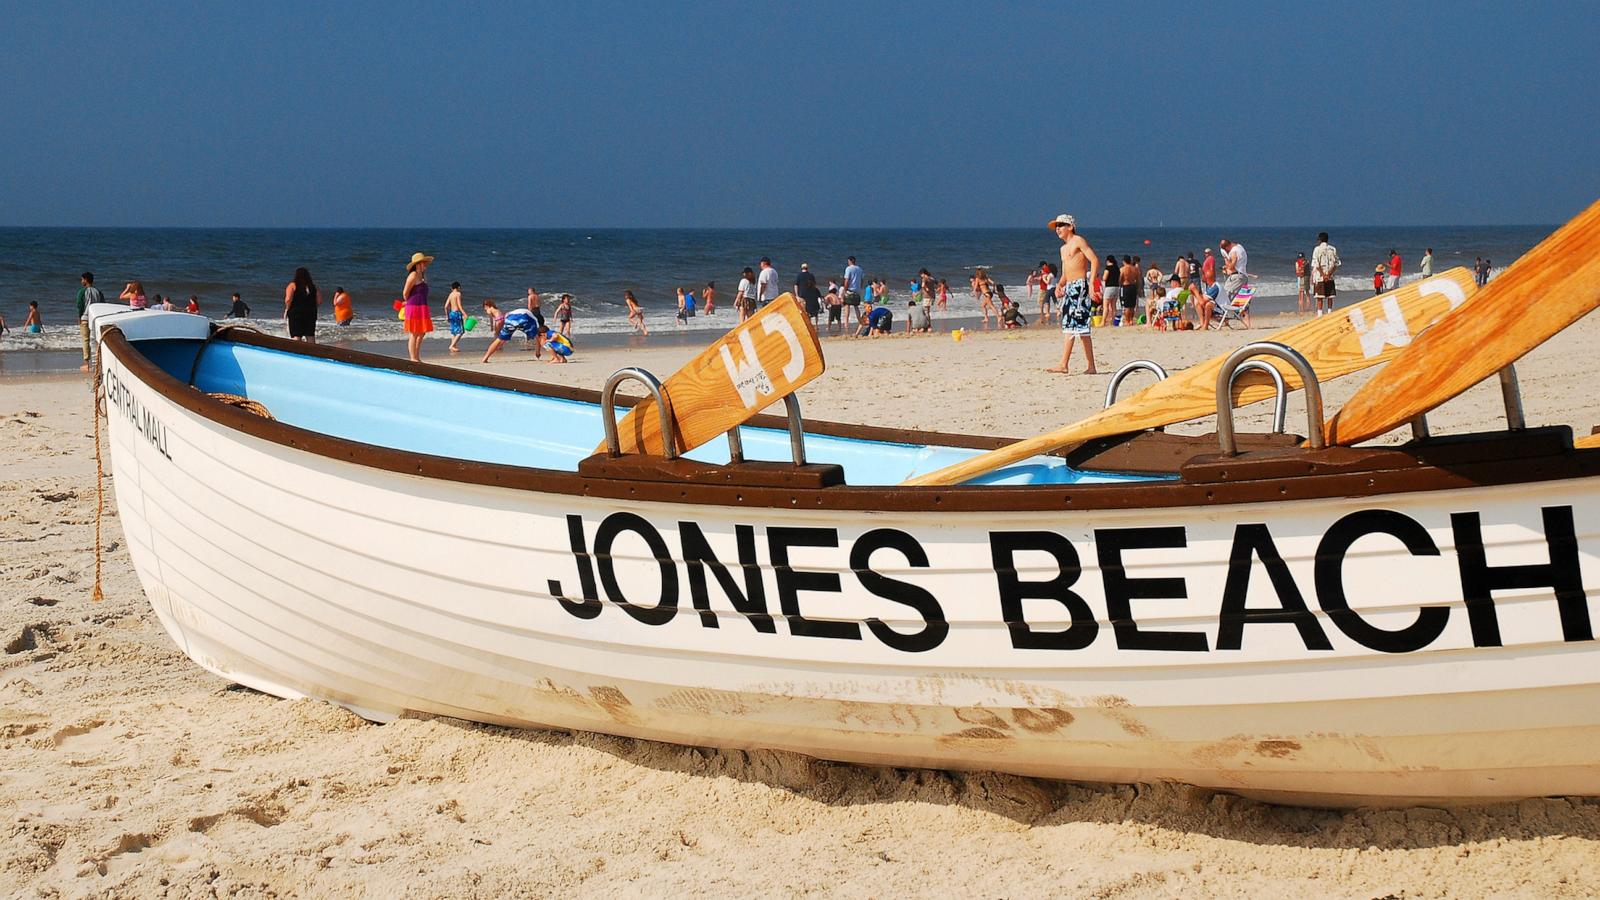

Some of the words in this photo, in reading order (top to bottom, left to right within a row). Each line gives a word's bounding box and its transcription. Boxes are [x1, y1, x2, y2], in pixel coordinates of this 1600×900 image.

[106, 367, 143, 433] CENTRAL
[143, 406, 173, 461] MALL
[547, 511, 949, 652] JONES
[988, 505, 1595, 654] BEACH
